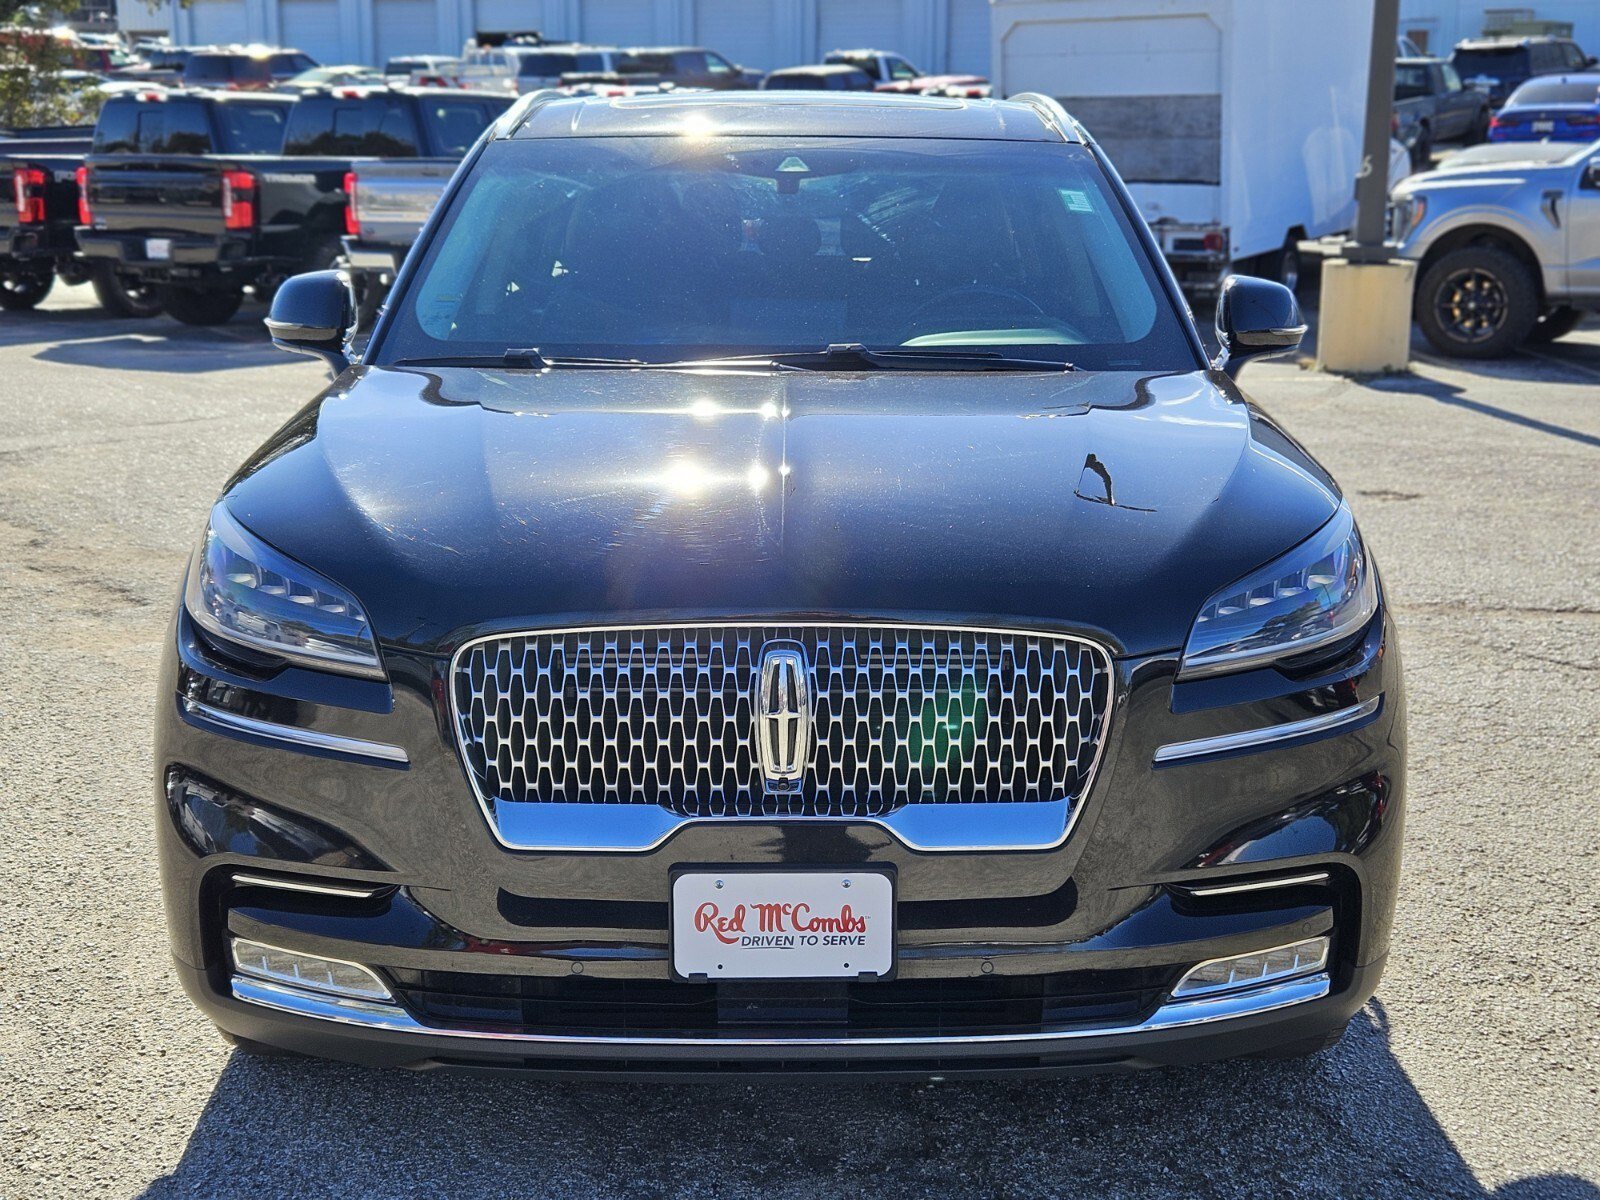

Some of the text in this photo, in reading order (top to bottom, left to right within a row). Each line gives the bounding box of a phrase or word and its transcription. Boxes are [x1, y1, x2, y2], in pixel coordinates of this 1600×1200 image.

[694, 902, 866, 944] Red McCombs
[741, 935, 866, 947] DRIVEN TO SERVE
